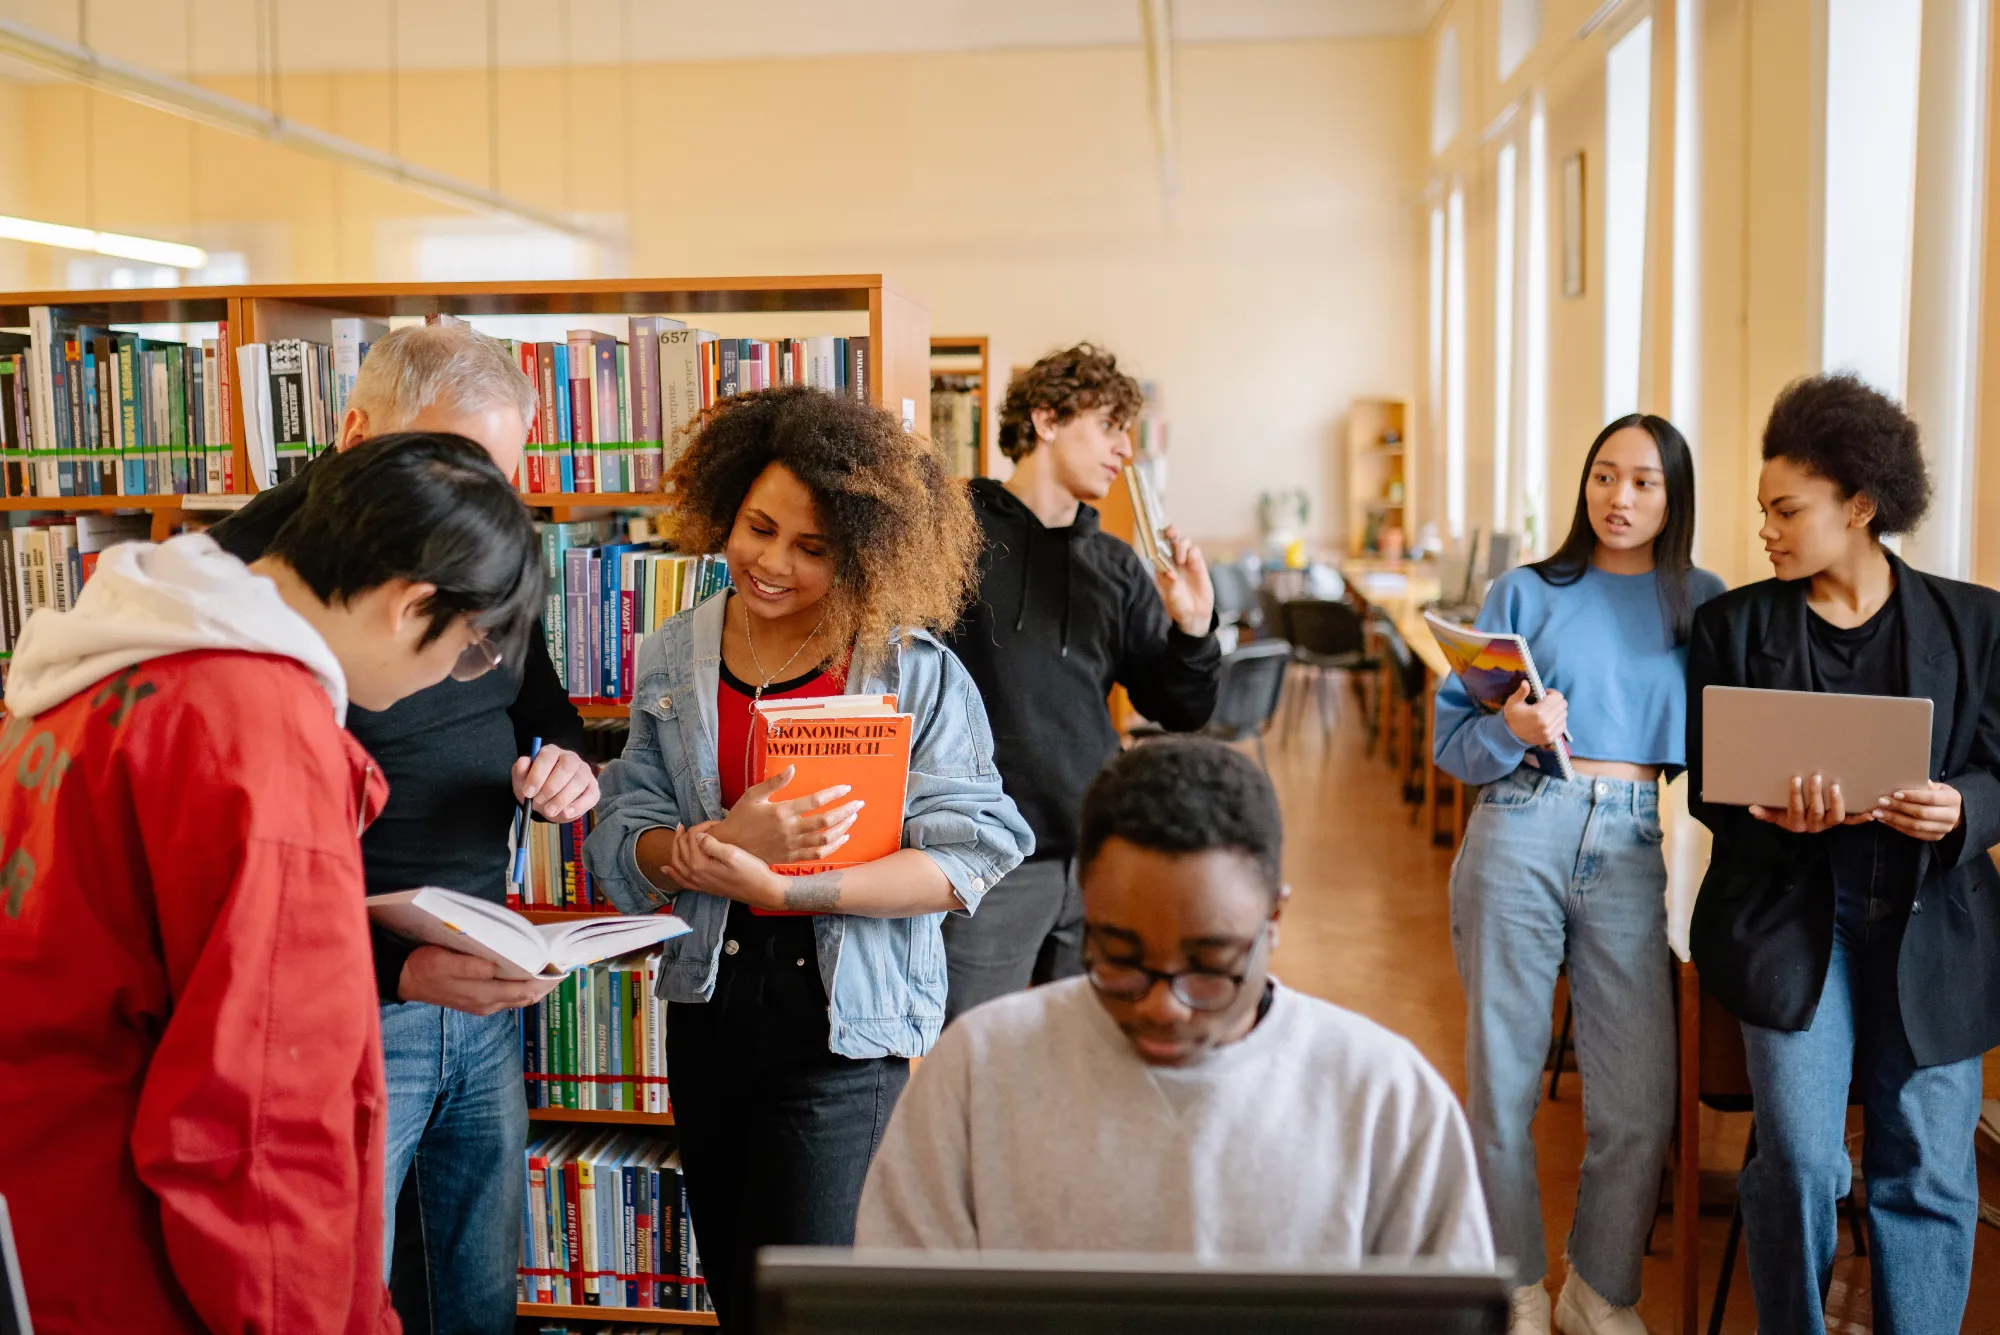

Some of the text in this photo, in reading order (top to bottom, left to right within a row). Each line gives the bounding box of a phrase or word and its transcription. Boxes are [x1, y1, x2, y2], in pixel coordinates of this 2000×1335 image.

[661, 332, 688, 344] 657
[120, 345, 134, 400] ЭКОНОМИКА
[684, 360, 695, 386] учет
[278, 376, 291, 442] МЕЖДУНАРОДНЫЙ
[288, 382, 300, 435] МАРКЕТИНГ
[554, 594, 563, 658] ФИНАНСОВЫЙ
[565, 861, 576, 904] УЧЕТ
[598, 1024, 607, 1074] ЛОГИСТИКА
[567, 1202, 578, 1262] ЛОГИСТИКА
[637, 1227, 646, 1272] ЛОГИСТИКА
